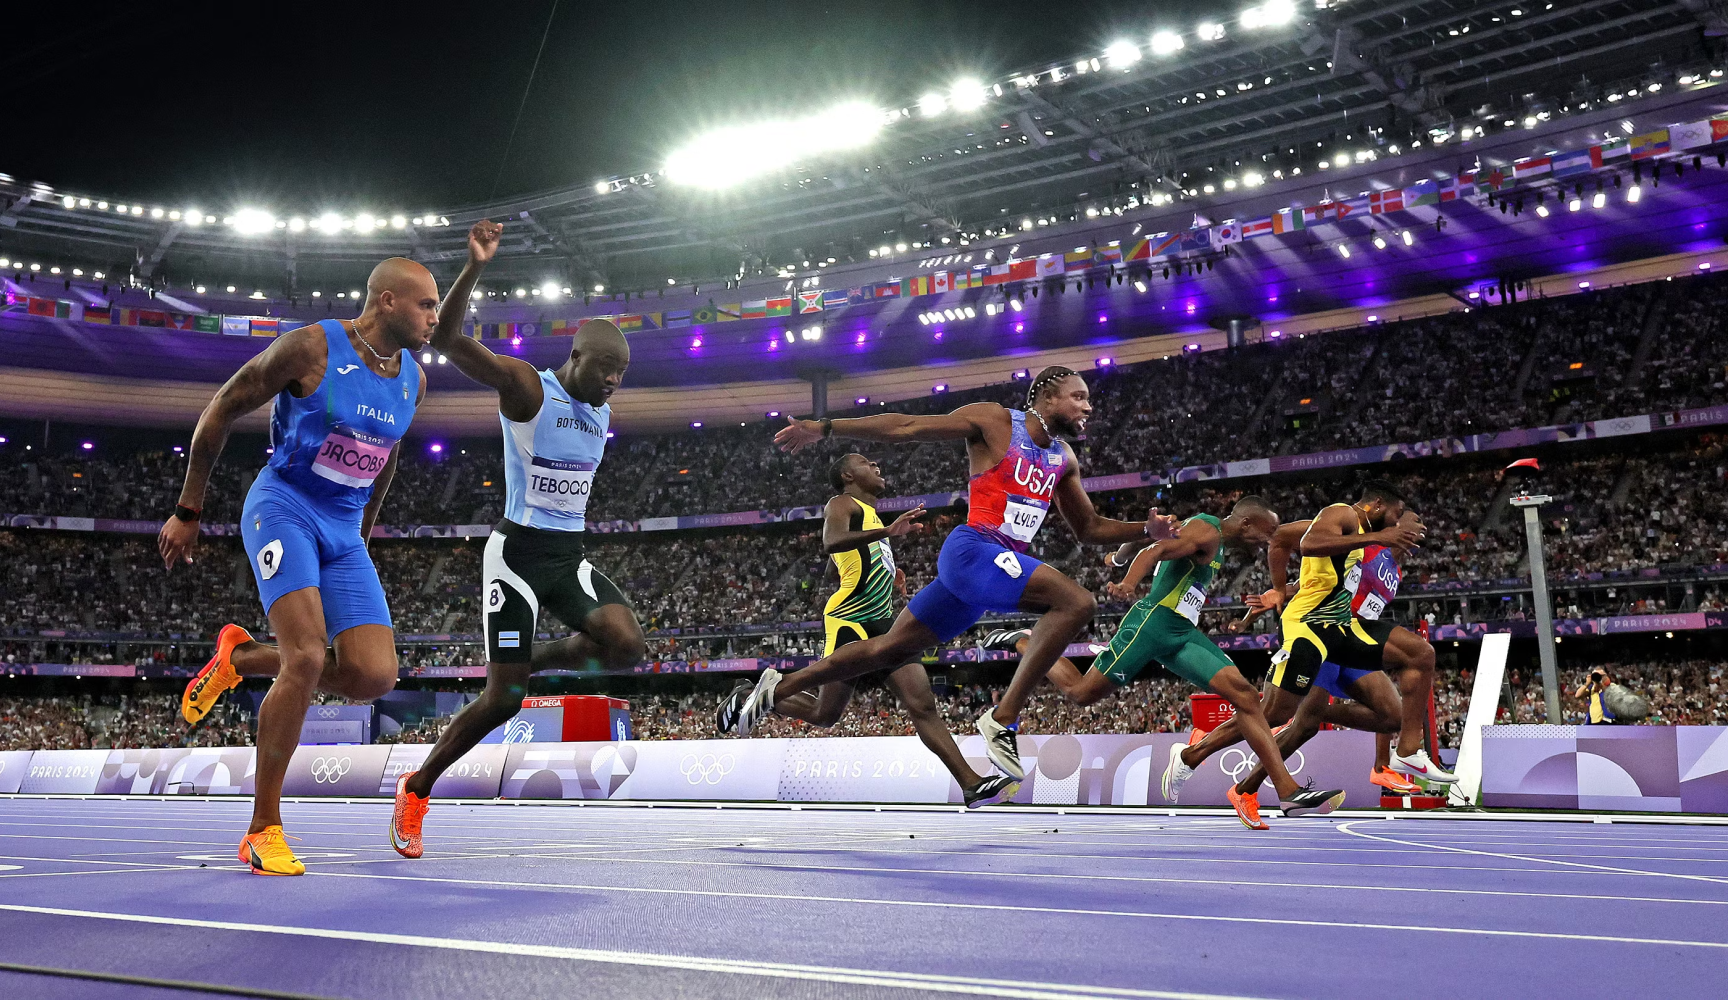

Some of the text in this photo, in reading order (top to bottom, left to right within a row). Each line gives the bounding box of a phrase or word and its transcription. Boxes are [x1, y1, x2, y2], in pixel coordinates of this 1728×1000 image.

[356, 404, 396, 425] ITALIA
[1681, 410, 1722, 423] PARIS
[556, 417, 604, 440] BOTSWANA
[321, 441, 385, 472] JACOBS
[1292, 453, 1358, 467] PARIS 2024
[531, 474, 589, 495] TEBOGO
[1014, 457, 1056, 497] USA
[264, 550, 273, 569] 9
[1378, 562, 1398, 597] USA
[490, 589, 499, 606] 8
[1614, 618, 1687, 628] PARIS 2024
[730, 660, 748, 668] 2024
[539, 699, 561, 707] OMEGA
[30, 764, 96, 778] PARIS 2024
[446, 761, 492, 778] 2024
[794, 759, 937, 778] PARIS 2024
